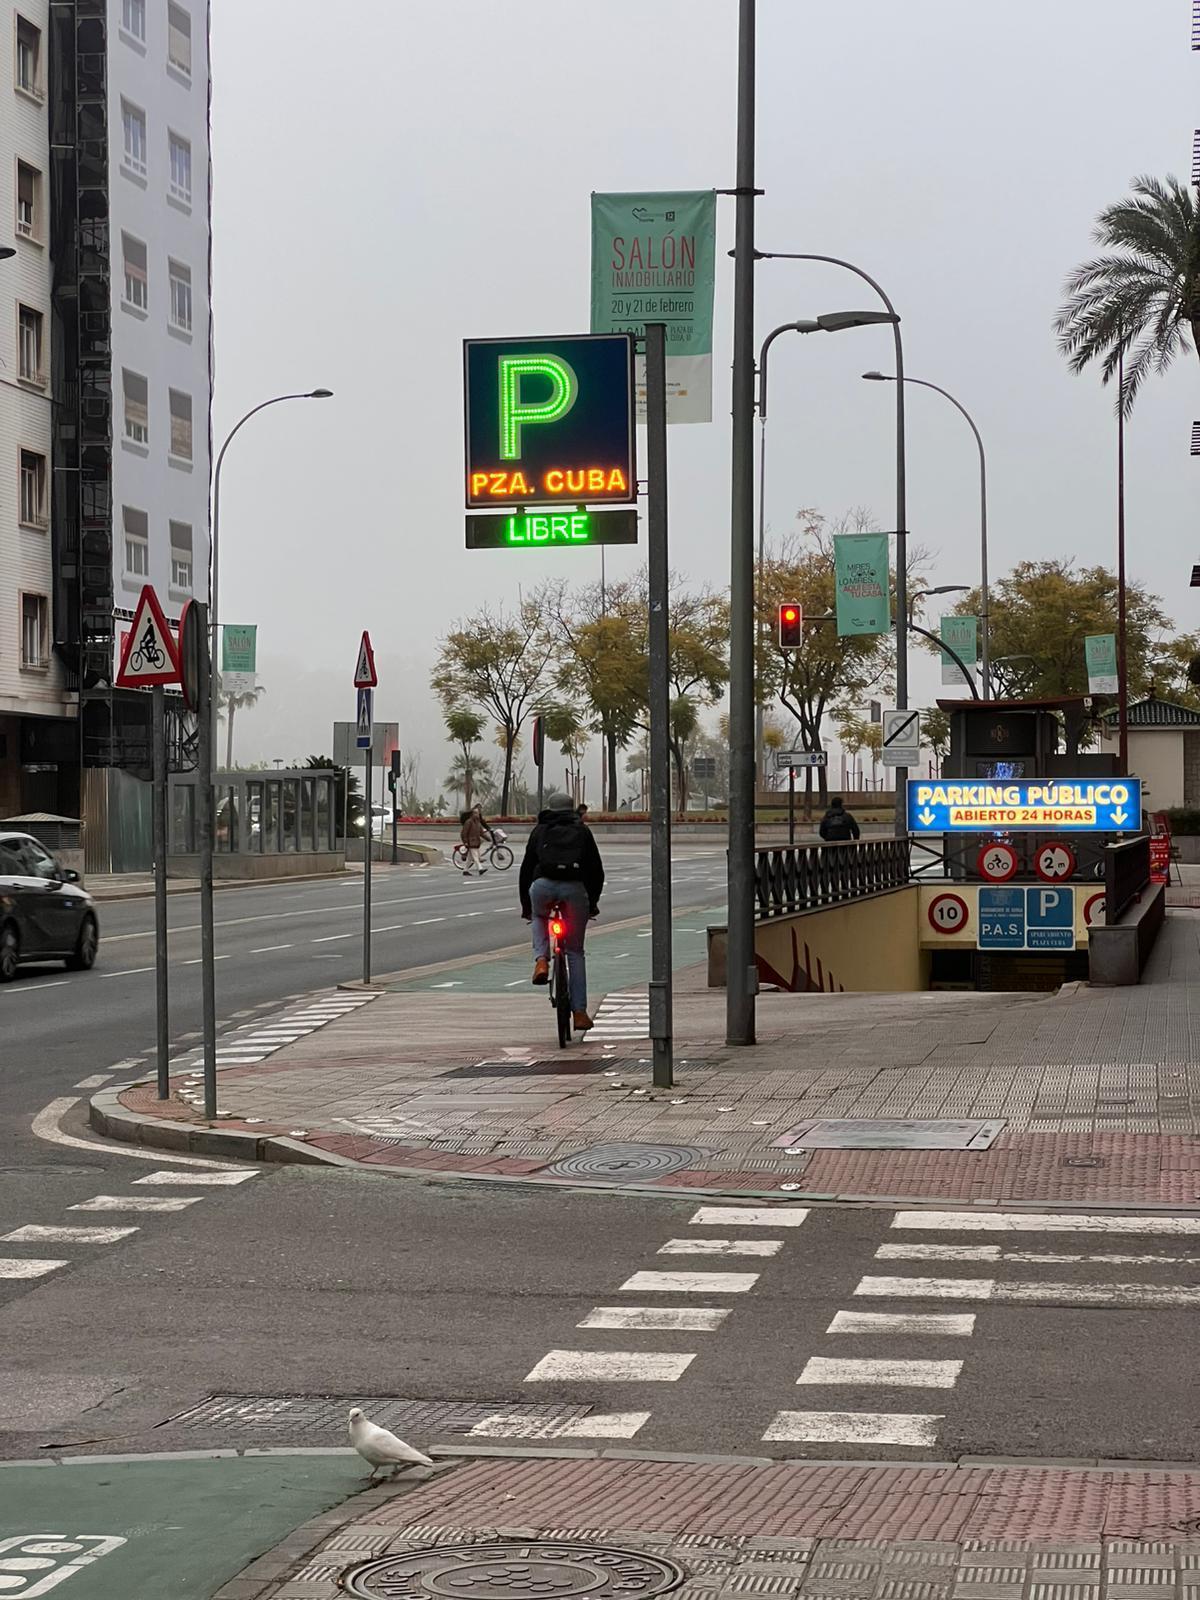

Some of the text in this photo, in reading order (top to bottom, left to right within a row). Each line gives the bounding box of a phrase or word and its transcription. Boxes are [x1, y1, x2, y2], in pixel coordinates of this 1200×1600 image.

[612, 229, 695, 271] SALÓN
[612, 270, 695, 288] INMOBILIARIO
[611, 298, 694, 316] 20 y 21 de febrero
[498, 353, 579, 460] P
[471, 468, 627, 497] PZA. CUBA
[508, 514, 589, 541] LIBRE
[917, 781, 1129, 806] PARKING PÚBLICO
[954, 810, 1093, 821] ABIERTO 24 HORAS
[1044, 857, 1054, 869] 2
[938, 907, 958, 920] 10
[1040, 889, 1060, 917] P
[982, 923, 1023, 936] P.A.S.
